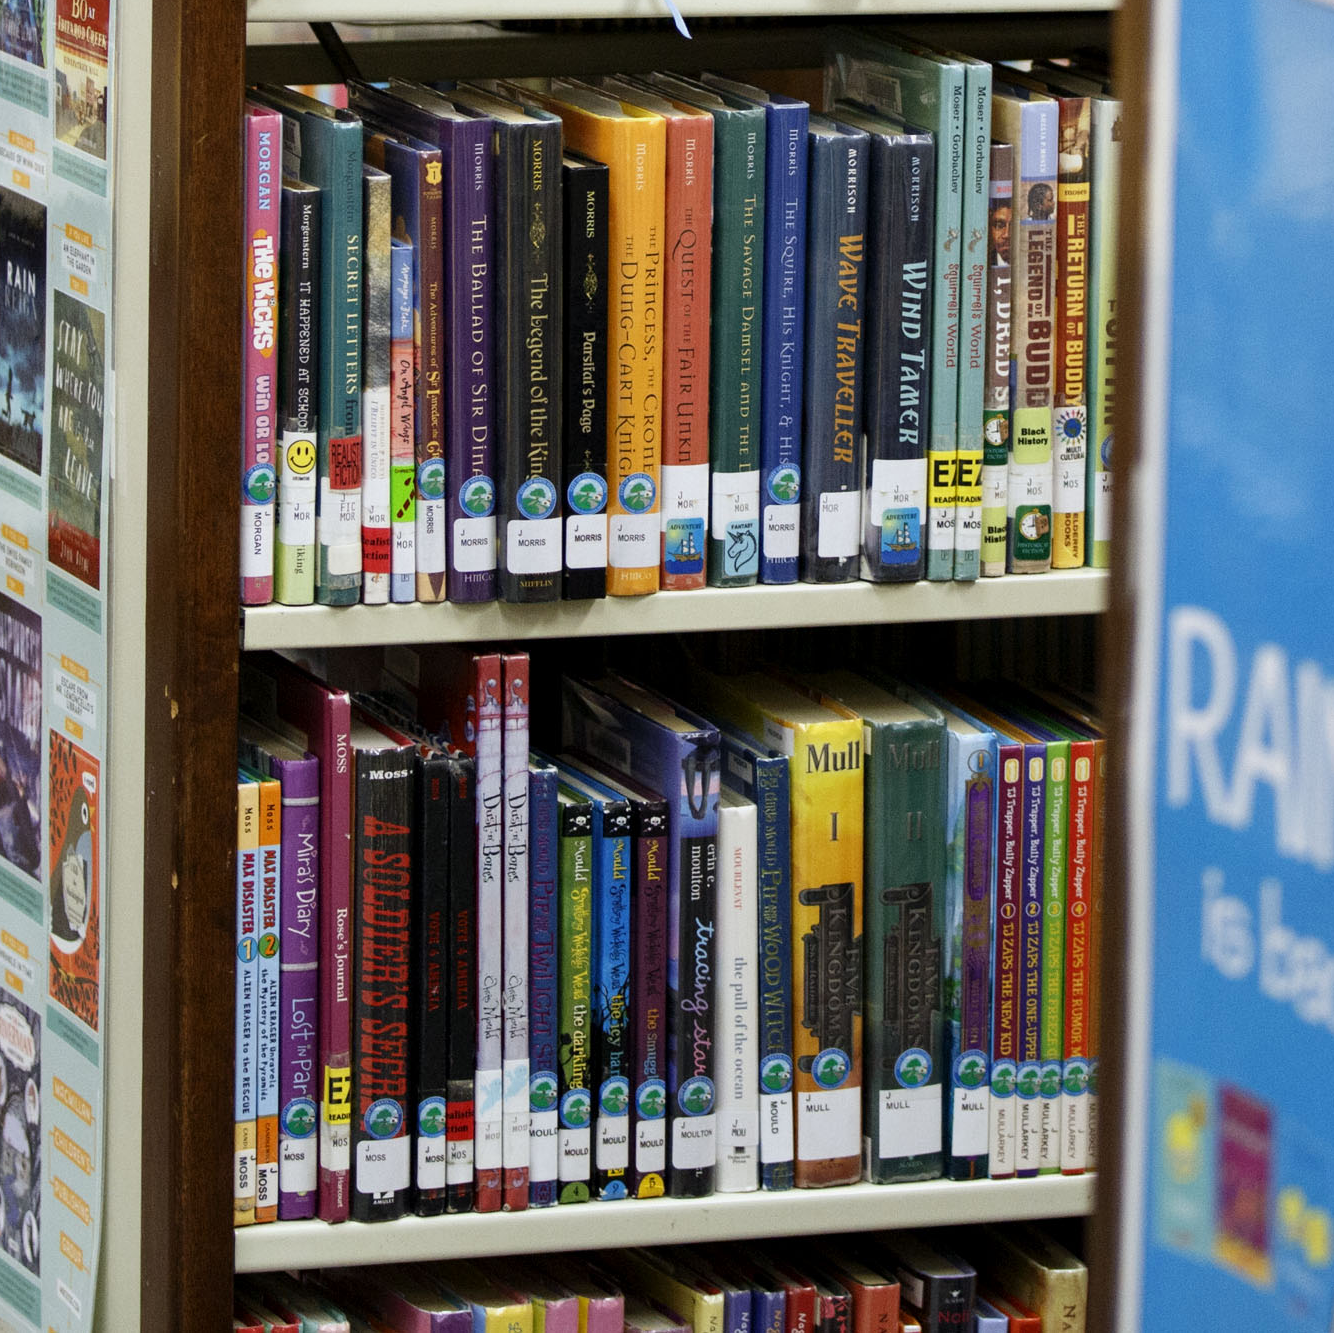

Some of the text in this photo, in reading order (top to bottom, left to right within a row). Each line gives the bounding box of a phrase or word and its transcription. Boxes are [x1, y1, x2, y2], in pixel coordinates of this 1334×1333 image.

[259, 132, 271, 211] MORGAN
[847, 148, 857, 215] MORRISON
[300, 204, 312, 269] Morgenstern
[472, 214, 487, 255] THE
[7, 260, 36, 298] RAIN
[253, 235, 274, 350] THE KICKS
[346, 234, 359, 306] SECRET
[470, 262, 487, 344] BALLAD
[530, 273, 549, 309] The
[57, 319, 84, 366] STAY
[739, 193, 757, 455] THE SAVAGE DAMSEL AND THE
[1065, 215, 1086, 407] THE RETURN OF BUDDY
[345, 313, 359, 395] LETTERS
[470, 350, 484, 376] OF
[525, 315, 548, 381] Legend
[833, 233, 863, 464] WAVE TRAVELLER
[898, 259, 928, 444] WIND TAMER
[55, 362, 84, 405] WHERE
[255, 375, 271, 439] WIN OR
[530, 385, 548, 405] of
[579, 331, 596, 434] Parsifal's Page
[530, 408, 548, 437] the
[1017, 437, 1049, 447] History
[1020, 427, 1047, 437] Black
[65, 448, 94, 502] LEAVE
[336, 734, 347, 774] MOSS
[805, 740, 861, 774] Mull
[574, 839, 588, 882] Mould
[691, 845, 701, 902] moulton
[1002, 786, 1016, 900] TJ Trapper, Bully Zapper
[240, 853, 255, 935] MAX DISASTER
[288, 833, 317, 938] Mira's Diary
[360, 815, 411, 1009] A SOLDIER'S
[334, 907, 348, 1003] Rose's Journal
[1201, 865, 1255, 980] is
[681, 917, 715, 1016] tracing
[1000, 921, 1014, 1055] TJ ZAPS THE NEW KID
[267, 979, 277, 1089] ALIEN ERASER Unravels
[570, 1004, 588, 1090] the darkling
[607, 995, 624, 1046] the icy
[729, 957, 748, 1100] the pull of the ocean
[806, 1103, 831, 1112] MULL
[284, 1152, 305, 1161] MOSS
